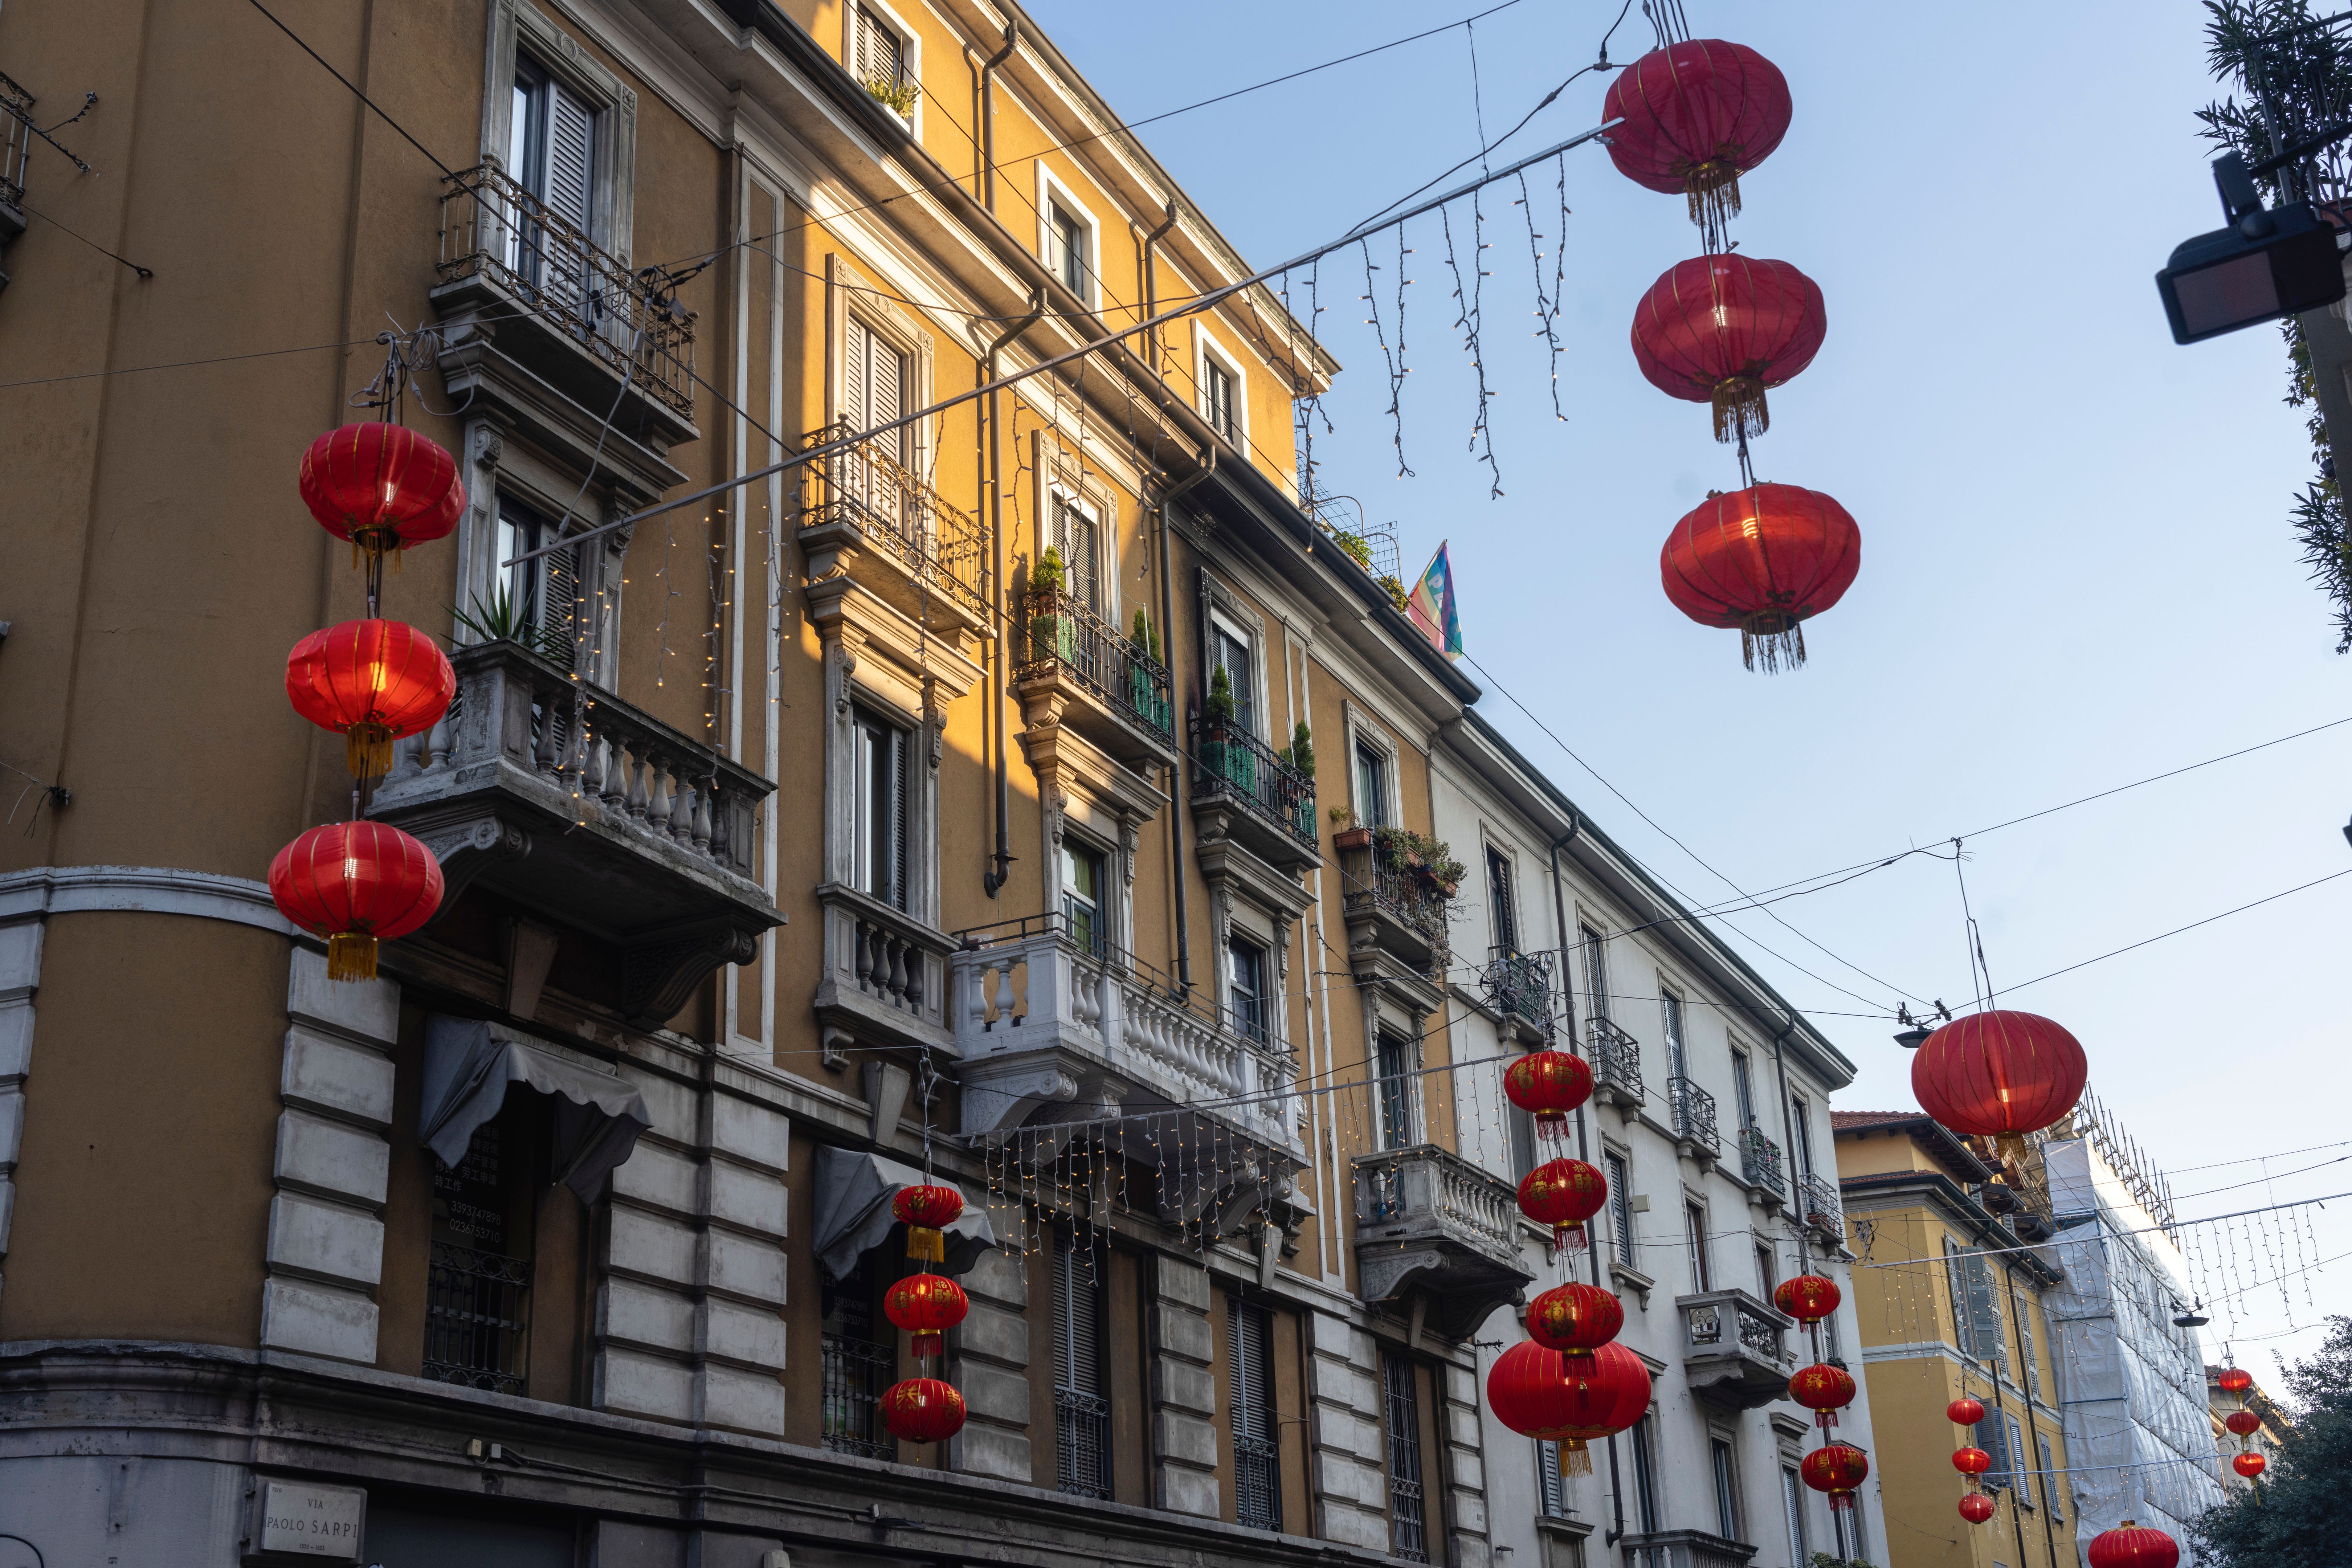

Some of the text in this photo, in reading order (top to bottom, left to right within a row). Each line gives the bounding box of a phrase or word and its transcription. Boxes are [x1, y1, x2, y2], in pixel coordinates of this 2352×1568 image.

[435, 1175, 462, 1192] 转工作
[462, 1166, 497, 1187] 劳工申请
[451, 1201, 501, 1225] 3393747898
[450, 1219, 500, 1243] 0236753710
[834, 1296, 868, 1312] 3393747898
[834, 1312, 868, 1327] 0236753710
[307, 1499, 323, 1509] VIA
[267, 1516, 357, 1538] PAOLO SARPI
